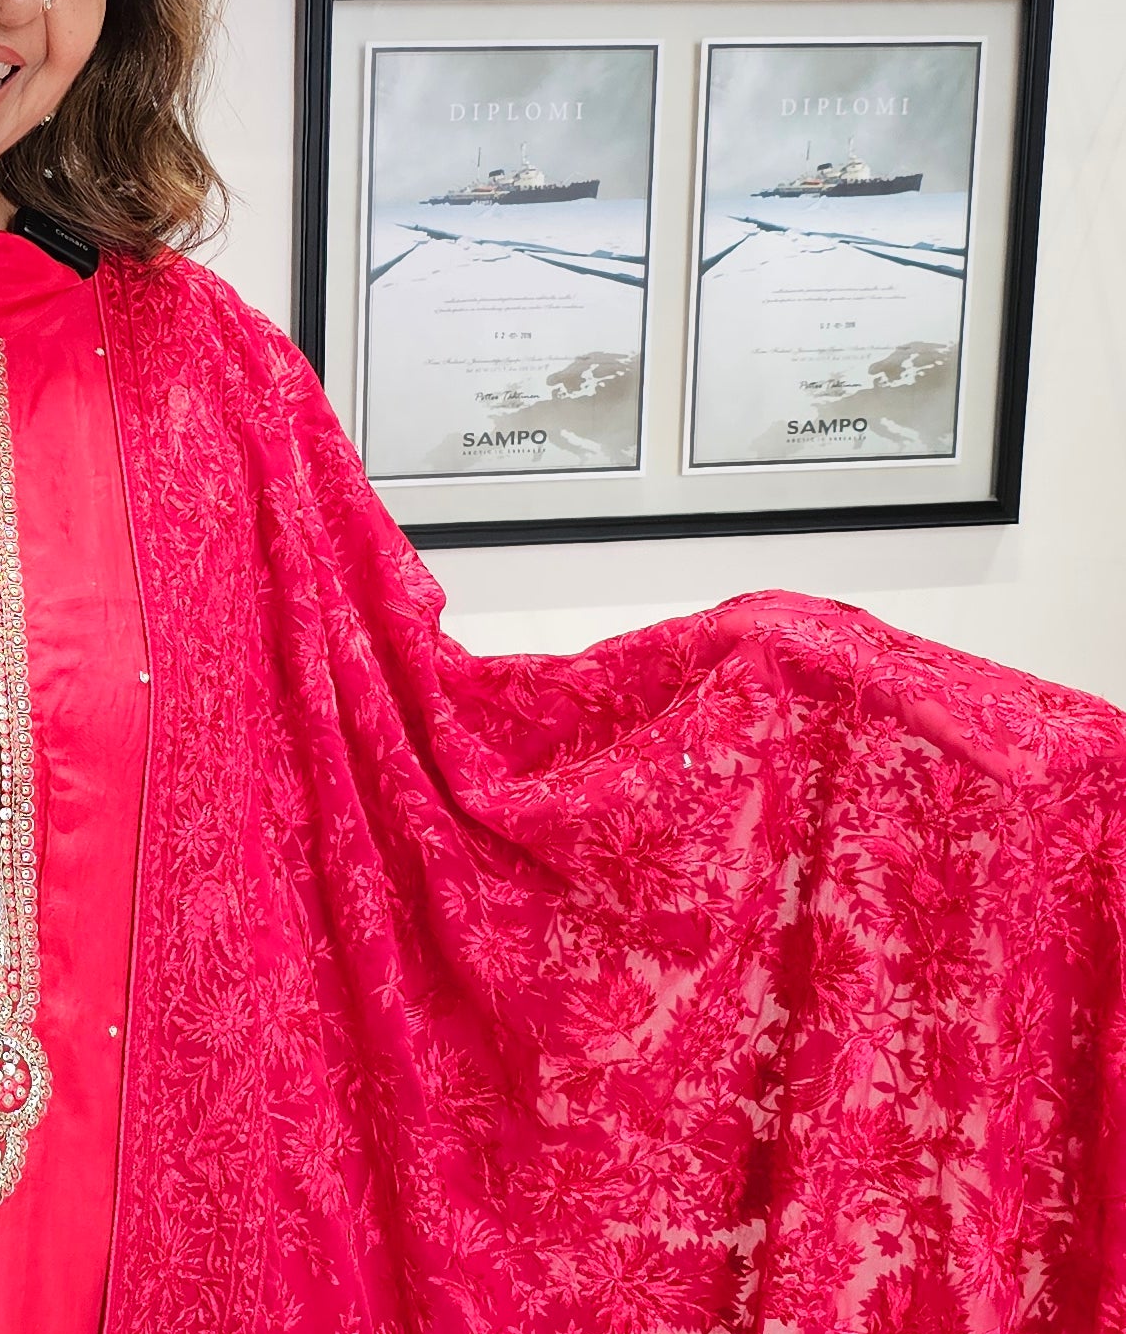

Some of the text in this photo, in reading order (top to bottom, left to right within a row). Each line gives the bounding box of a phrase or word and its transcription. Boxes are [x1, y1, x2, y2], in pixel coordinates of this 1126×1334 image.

[450, 101, 583, 121] DIPLOMI
[781, 97, 909, 116] DIPLOMI
[787, 418, 868, 436] SAMPO
[462, 429, 547, 448] SAMPO
